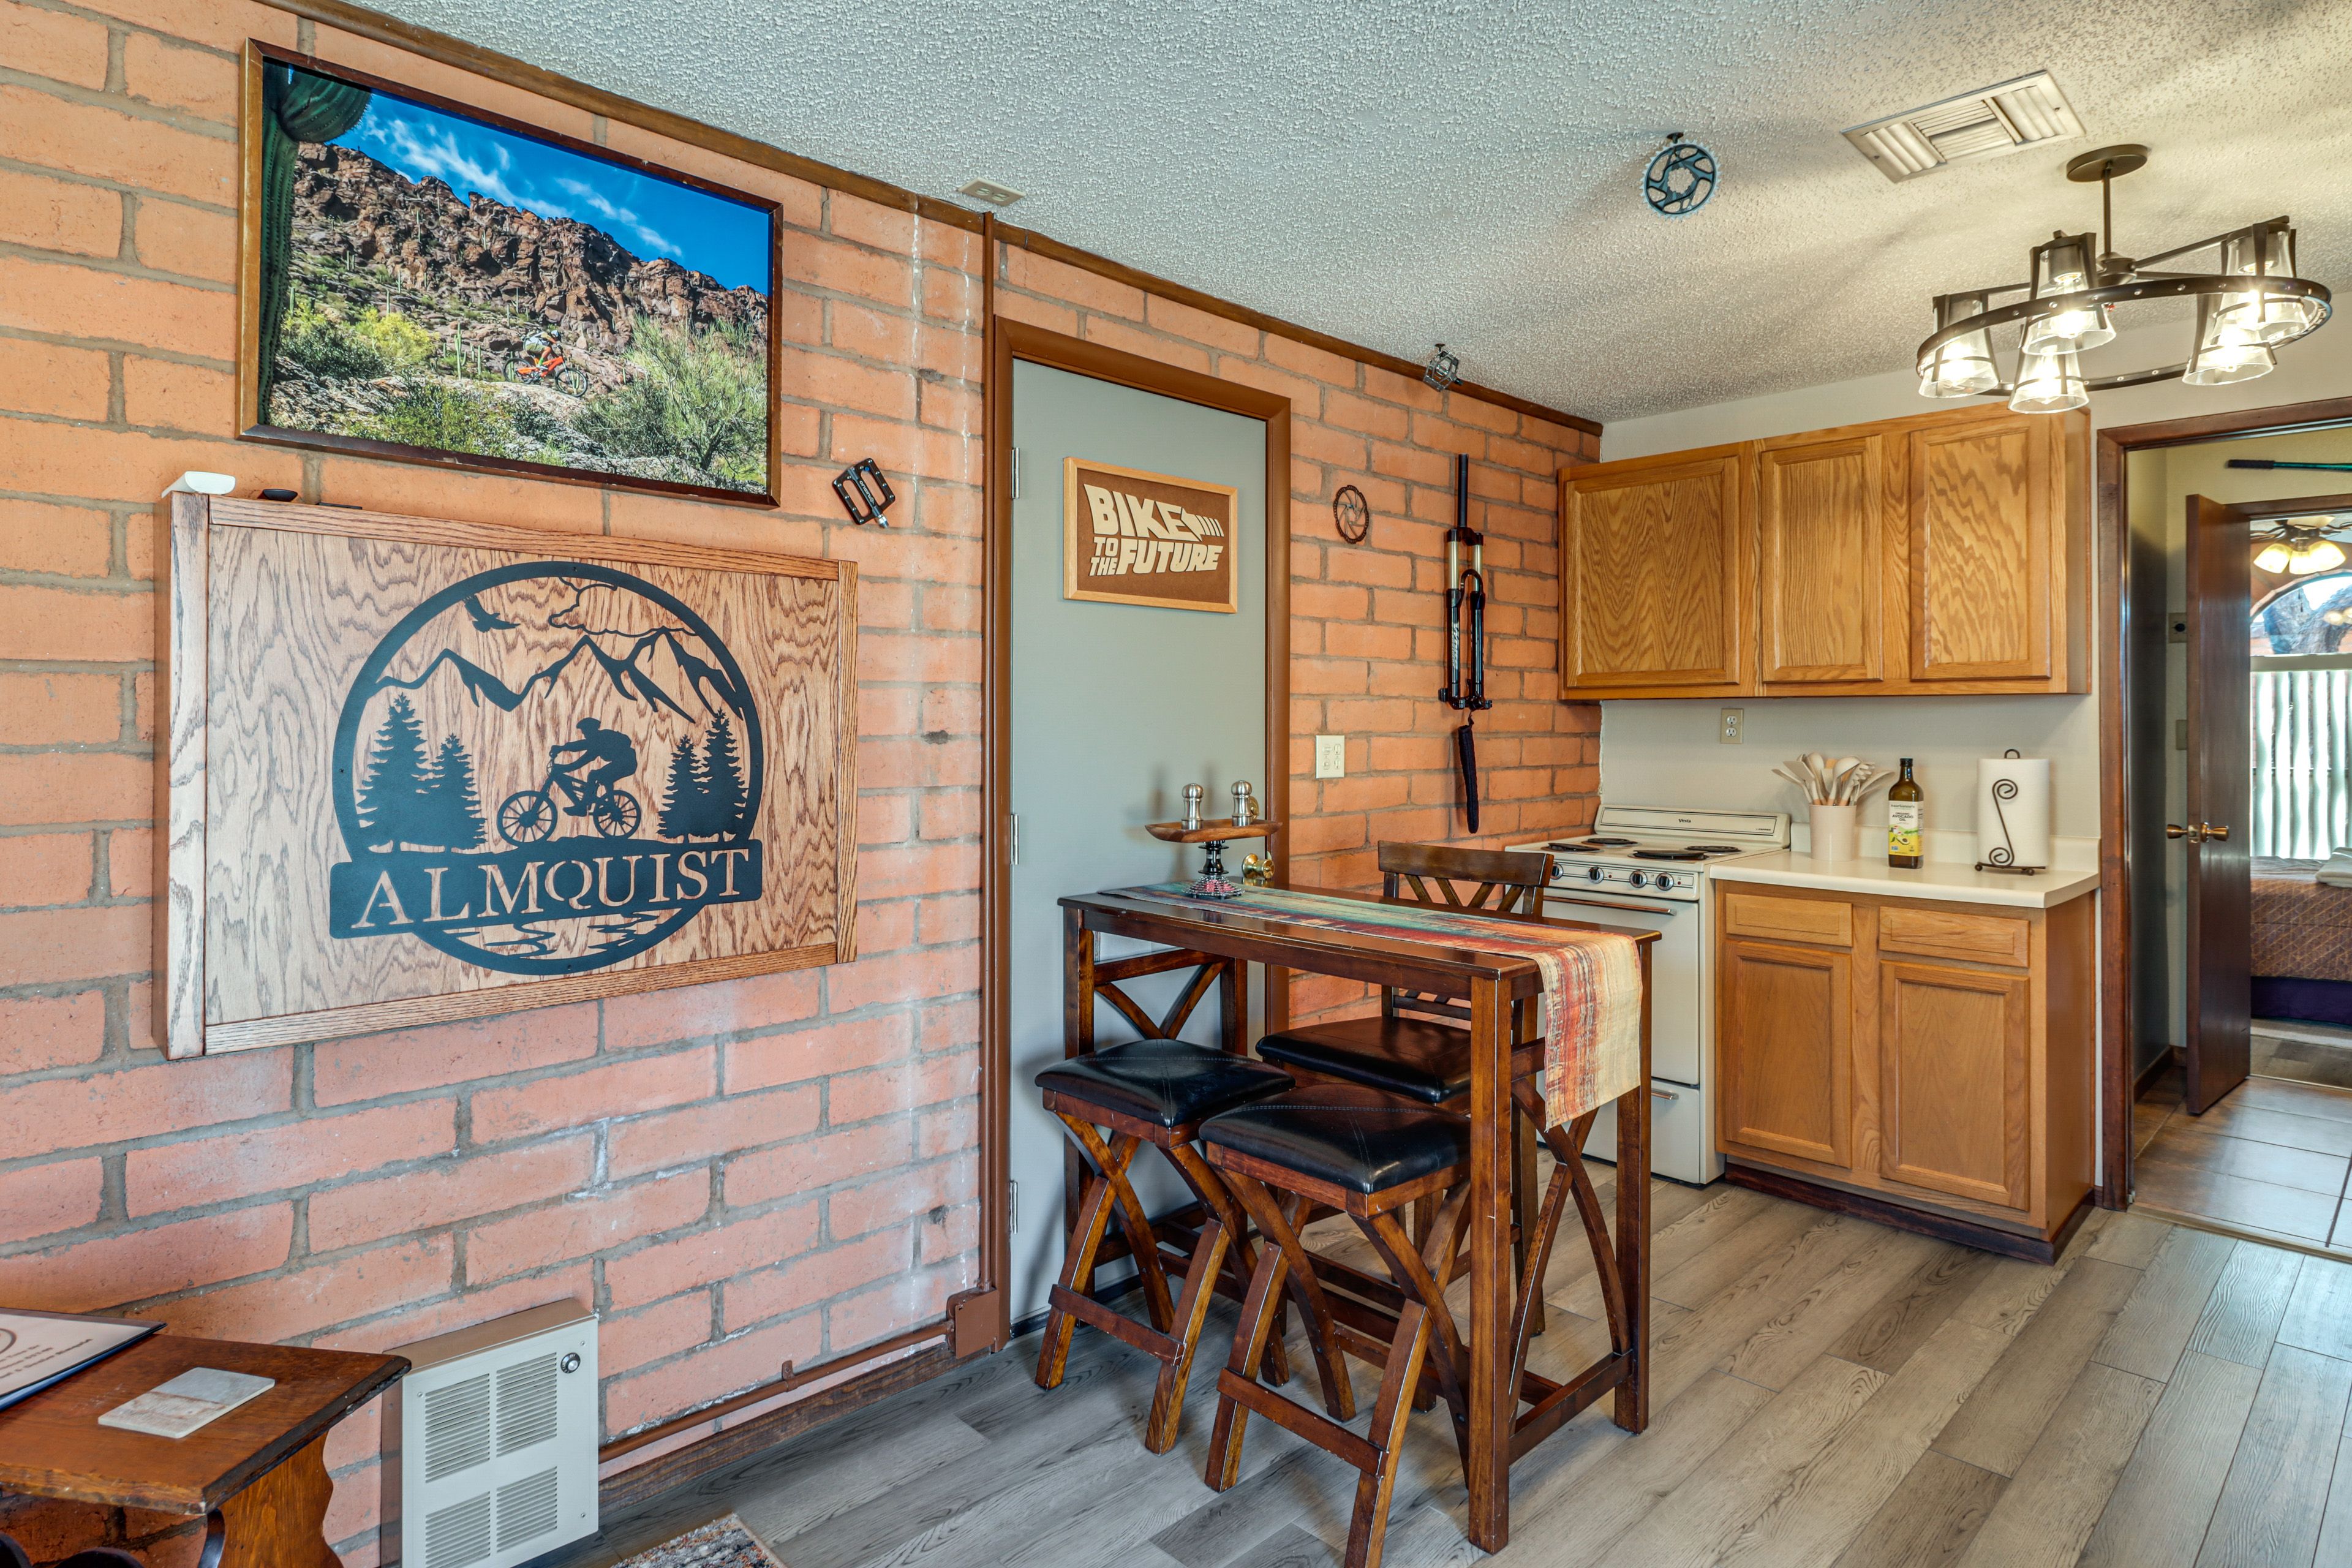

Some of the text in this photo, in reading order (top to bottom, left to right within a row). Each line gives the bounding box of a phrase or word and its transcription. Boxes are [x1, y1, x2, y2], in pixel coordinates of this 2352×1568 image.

[1083, 483, 1203, 541] BIKE
[1088, 538, 1224, 576] THE FUTURE
[1093, 536, 1119, 557] TO
[350, 848, 751, 930] ALMQUIST
